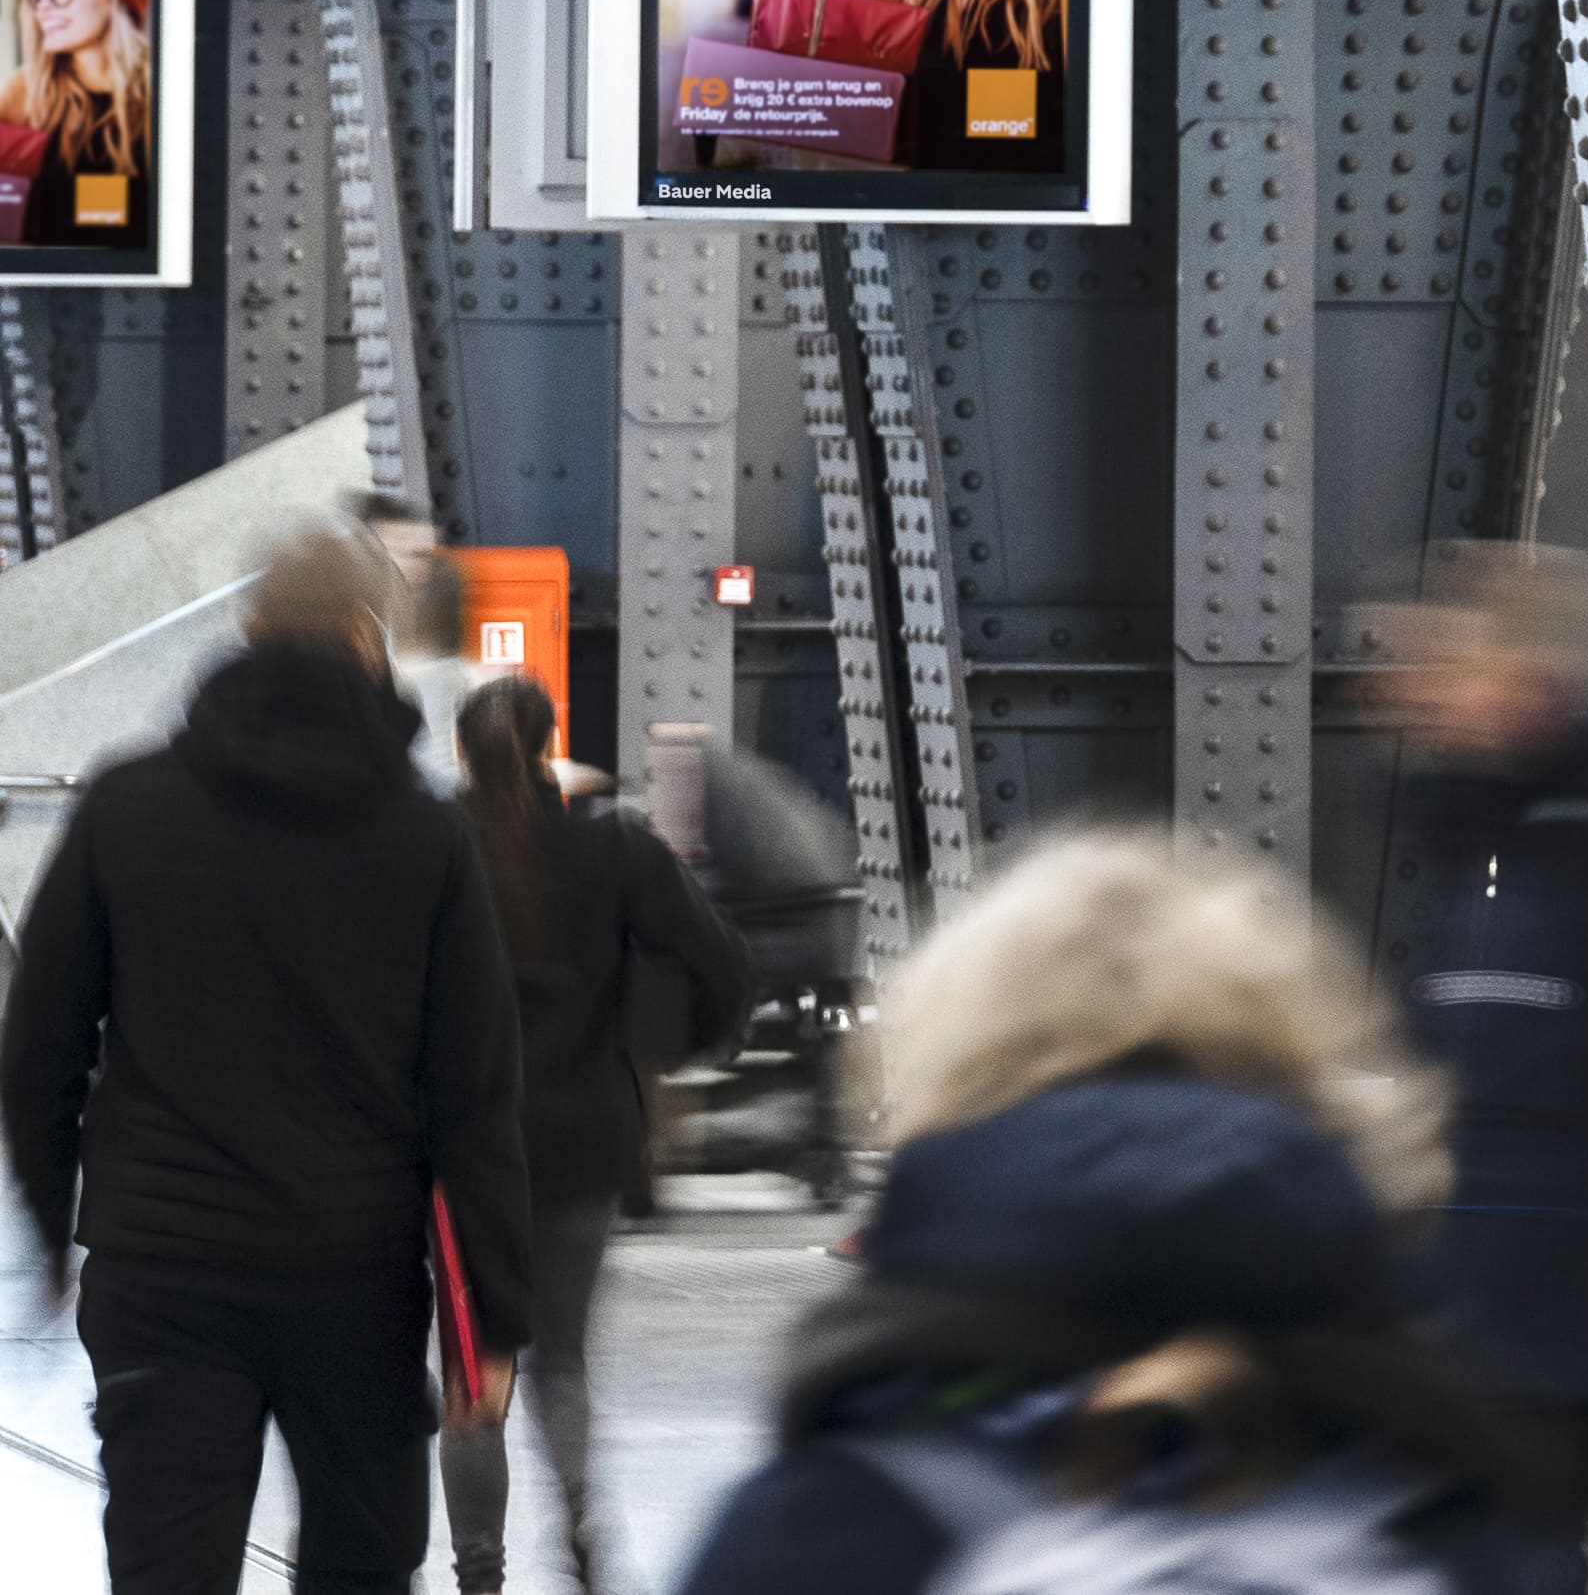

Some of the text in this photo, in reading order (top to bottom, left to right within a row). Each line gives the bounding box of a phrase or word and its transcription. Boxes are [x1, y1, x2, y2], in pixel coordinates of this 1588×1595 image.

[734, 77, 881, 93] Breng je gsm terug en
[734, 93, 893, 110] krijg 20 € extra bovenop
[680, 107, 727, 124] Friday
[734, 109, 828, 124] de retourprijs.
[658, 184, 771, 200] Bauer Media
